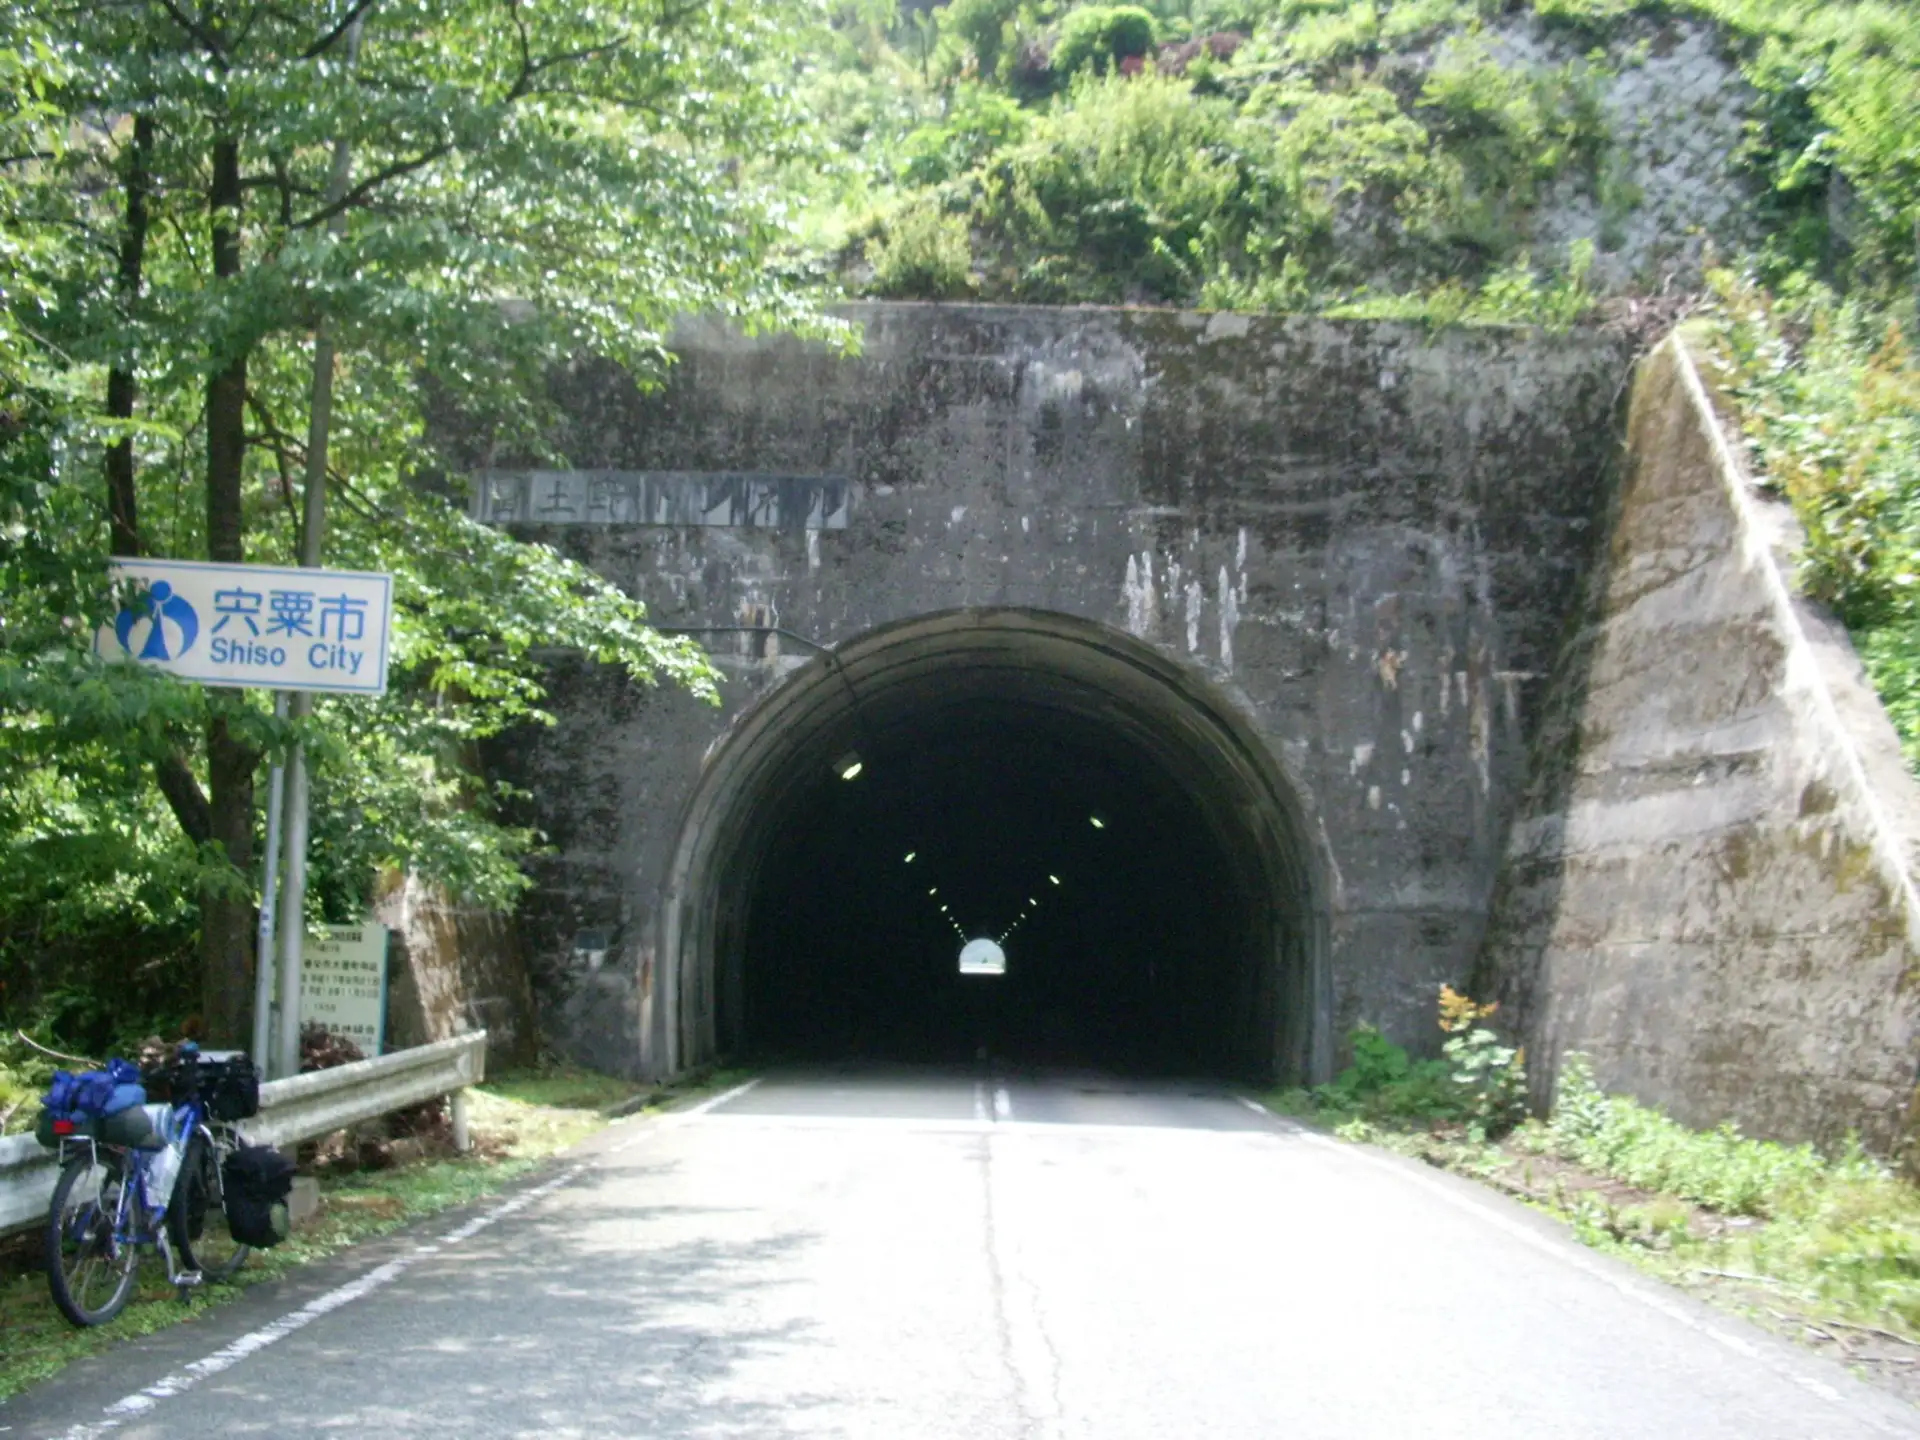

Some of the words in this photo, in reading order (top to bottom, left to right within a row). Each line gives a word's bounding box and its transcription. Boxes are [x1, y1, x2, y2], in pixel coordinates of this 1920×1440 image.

[210, 586, 369, 643] 宍粟市
[210, 637, 286, 667] Shiso
[307, 643, 363, 675] City
